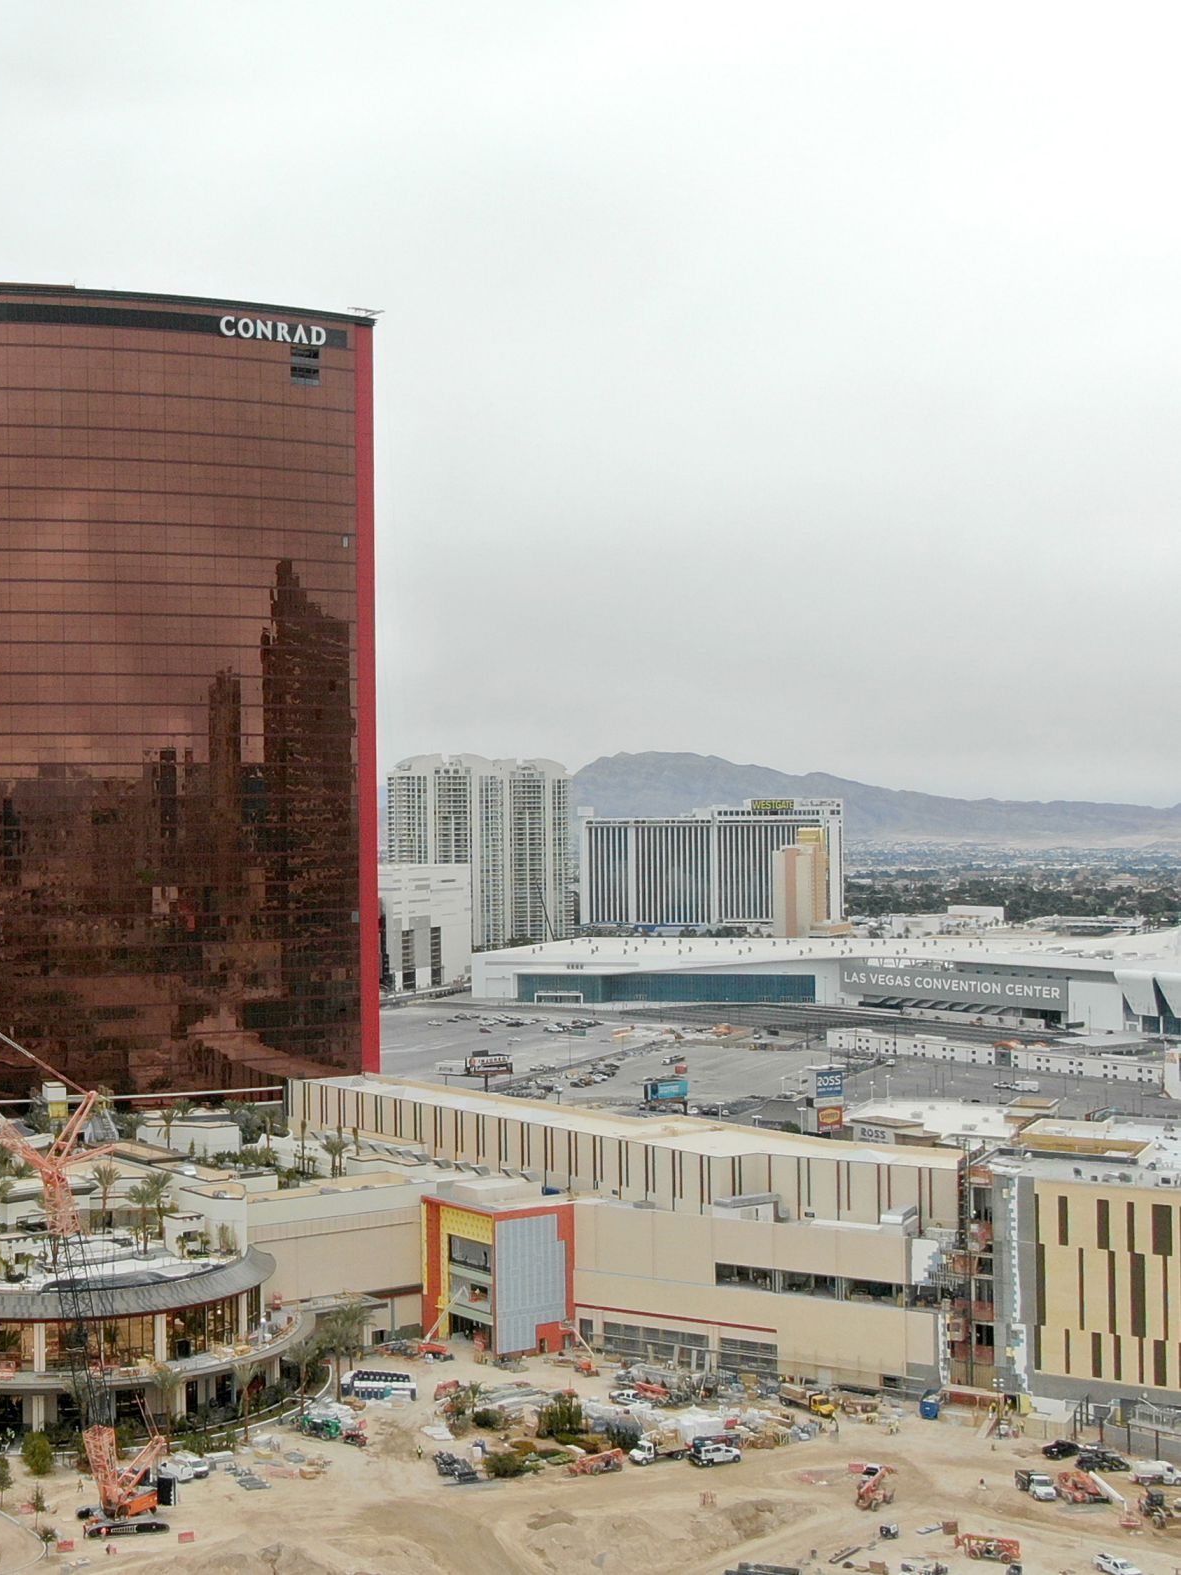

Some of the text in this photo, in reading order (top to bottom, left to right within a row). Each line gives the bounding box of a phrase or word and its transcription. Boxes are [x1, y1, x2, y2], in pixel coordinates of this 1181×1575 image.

[219, 315, 327, 346] CONRAD
[752, 799, 794, 810] WESTGATE
[843, 971, 1061, 1000] LAS VEGAS CONVENTION CENTER
[860, 1127, 886, 1140] ROSS
